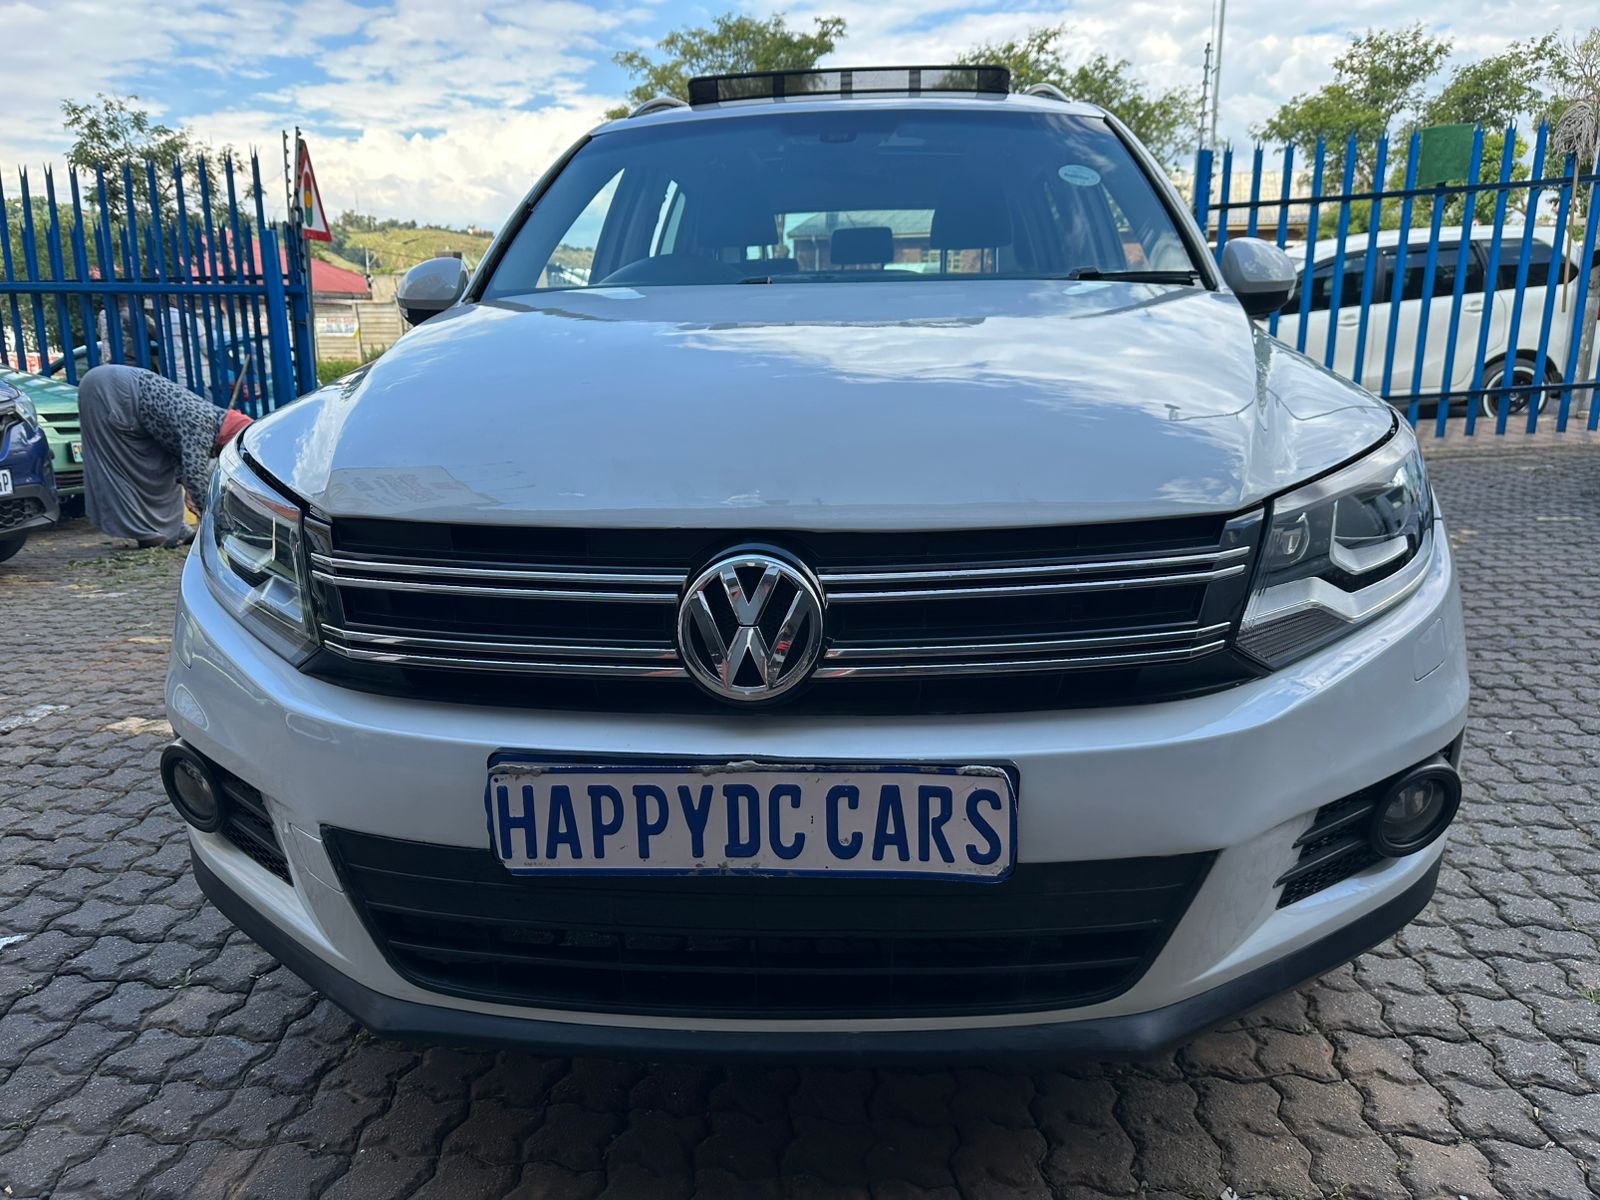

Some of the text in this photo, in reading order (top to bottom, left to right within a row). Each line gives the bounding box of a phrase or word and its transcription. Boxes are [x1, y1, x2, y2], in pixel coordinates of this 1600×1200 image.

[687, 561, 815, 693] VW
[496, 783, 1003, 865] HAPPYDC CARS
